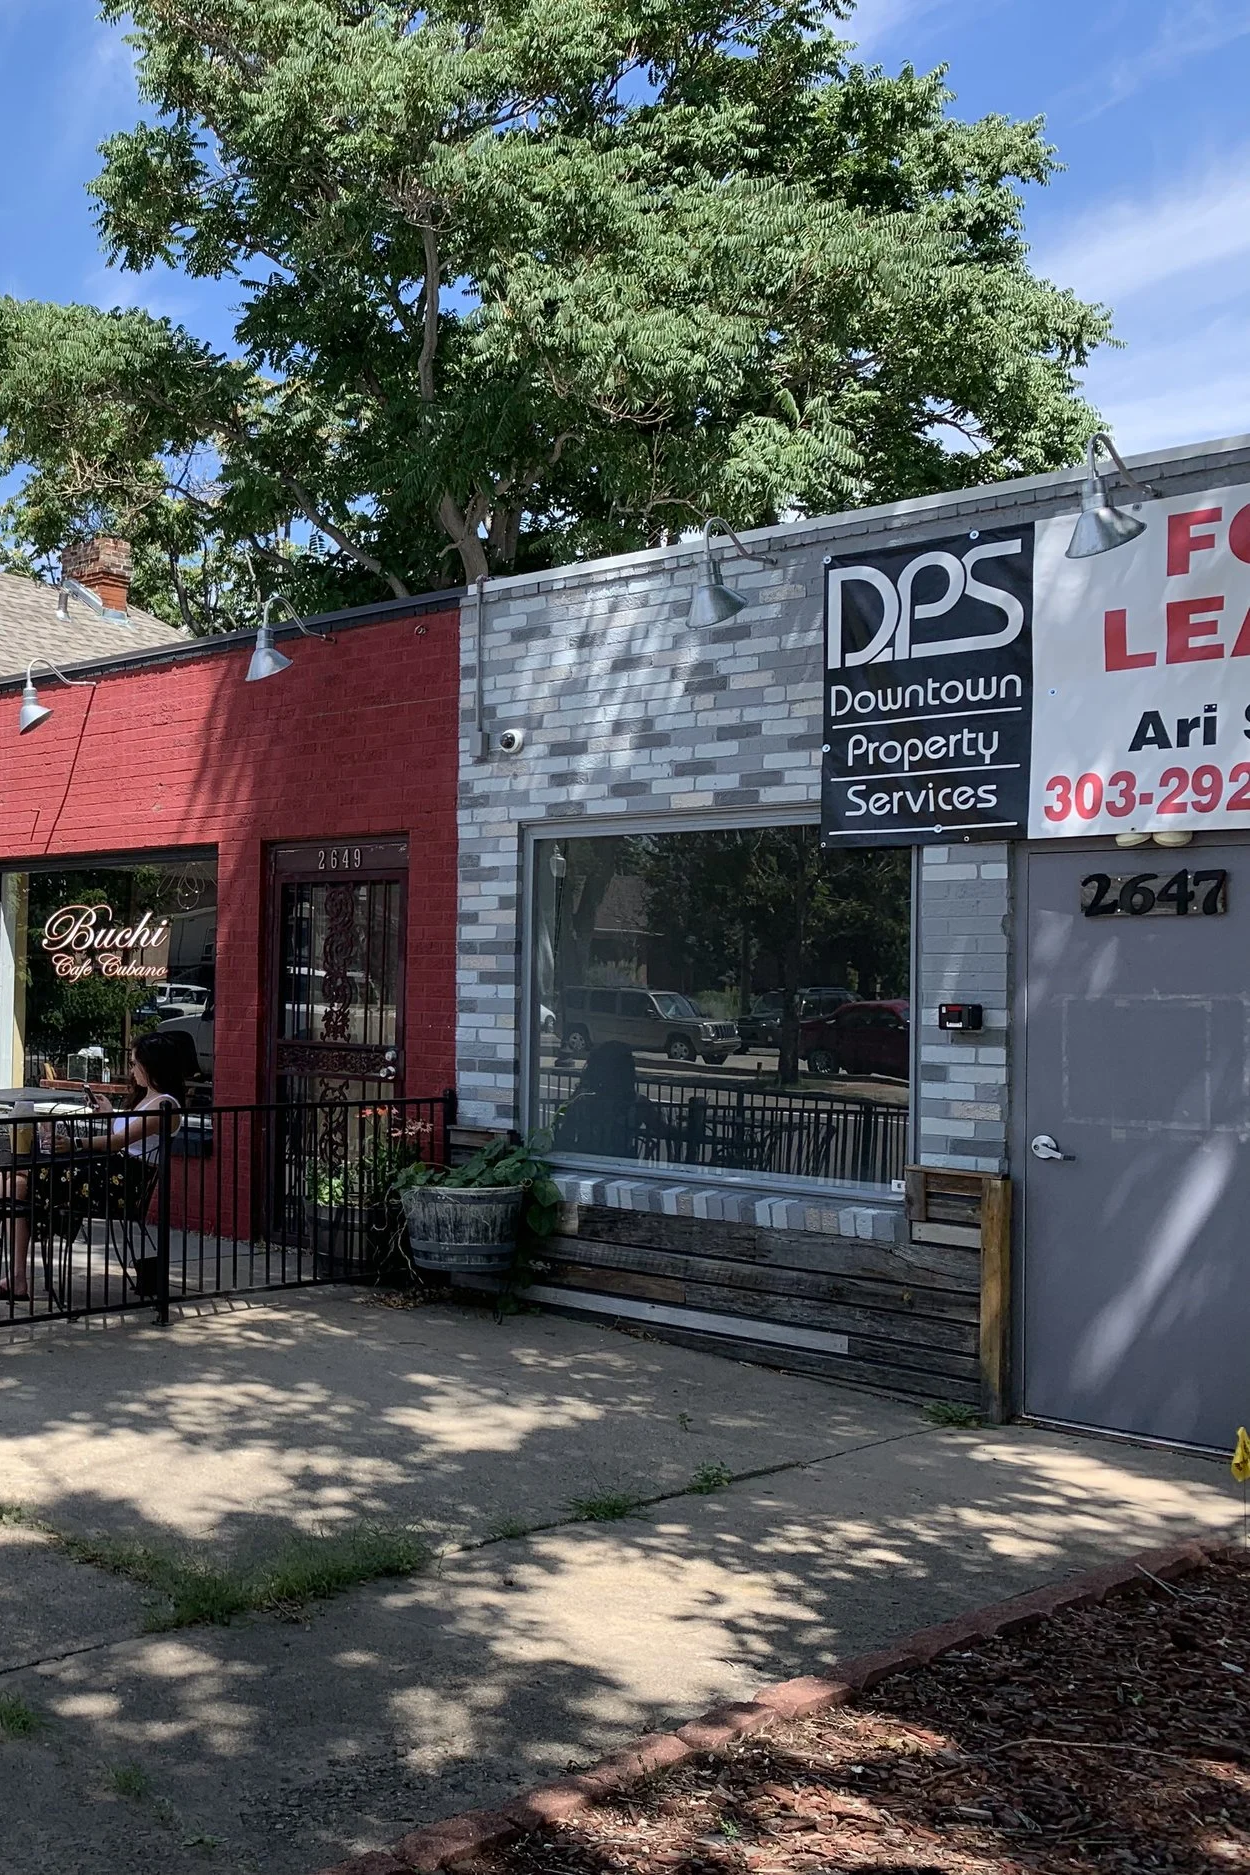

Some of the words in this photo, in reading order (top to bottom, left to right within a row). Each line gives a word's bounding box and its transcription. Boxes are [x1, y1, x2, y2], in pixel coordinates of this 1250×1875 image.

[827, 538, 1025, 670] DPS
[830, 674, 1022, 717] Downtown
[847, 728, 999, 771] Property
[1128, 704, 1217, 752] Ari
[845, 783, 997, 817] Services
[318, 848, 361, 870] 2649
[1081, 868, 1227, 917] 2647
[42, 904, 168, 950] Buchi
[52, 953, 92, 983] Cafe
[98, 953, 168, 977] Cubano
